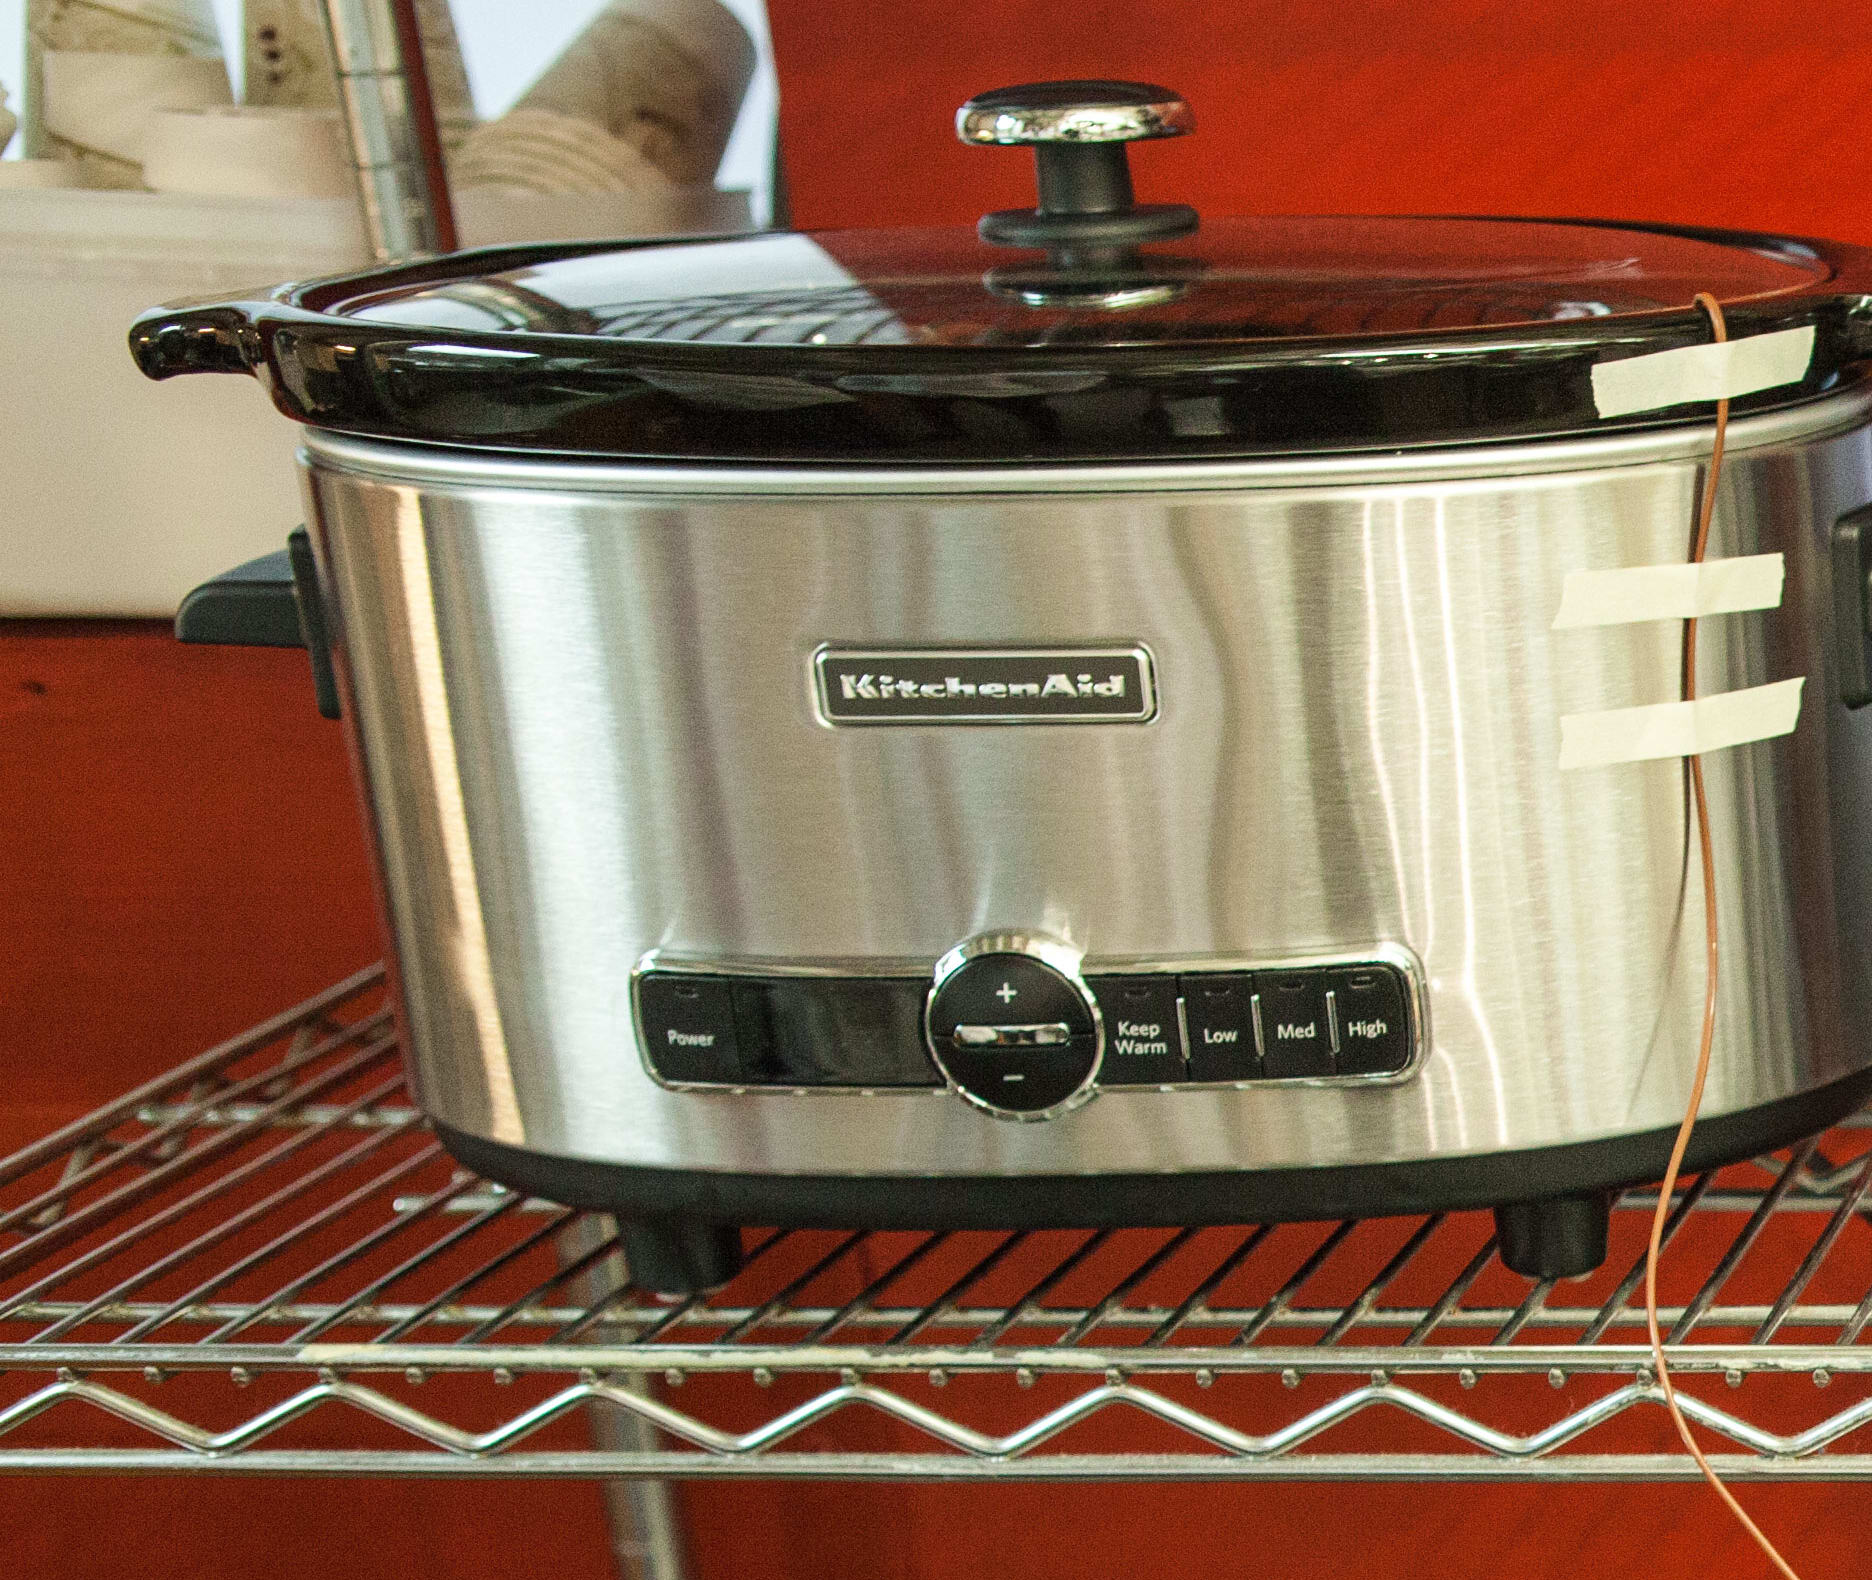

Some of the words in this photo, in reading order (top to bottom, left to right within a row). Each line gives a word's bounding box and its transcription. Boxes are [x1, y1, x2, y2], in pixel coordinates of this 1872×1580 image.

[839, 674, 1126, 700] KitchenAid
[667, 1029, 715, 1048] Power
[1117, 1020, 1161, 1038] Keep
[1204, 1028, 1239, 1044] Low
[1277, 1021, 1317, 1040] Med
[1348, 1019, 1388, 1039] High
[1114, 1039, 1169, 1055] Warm
